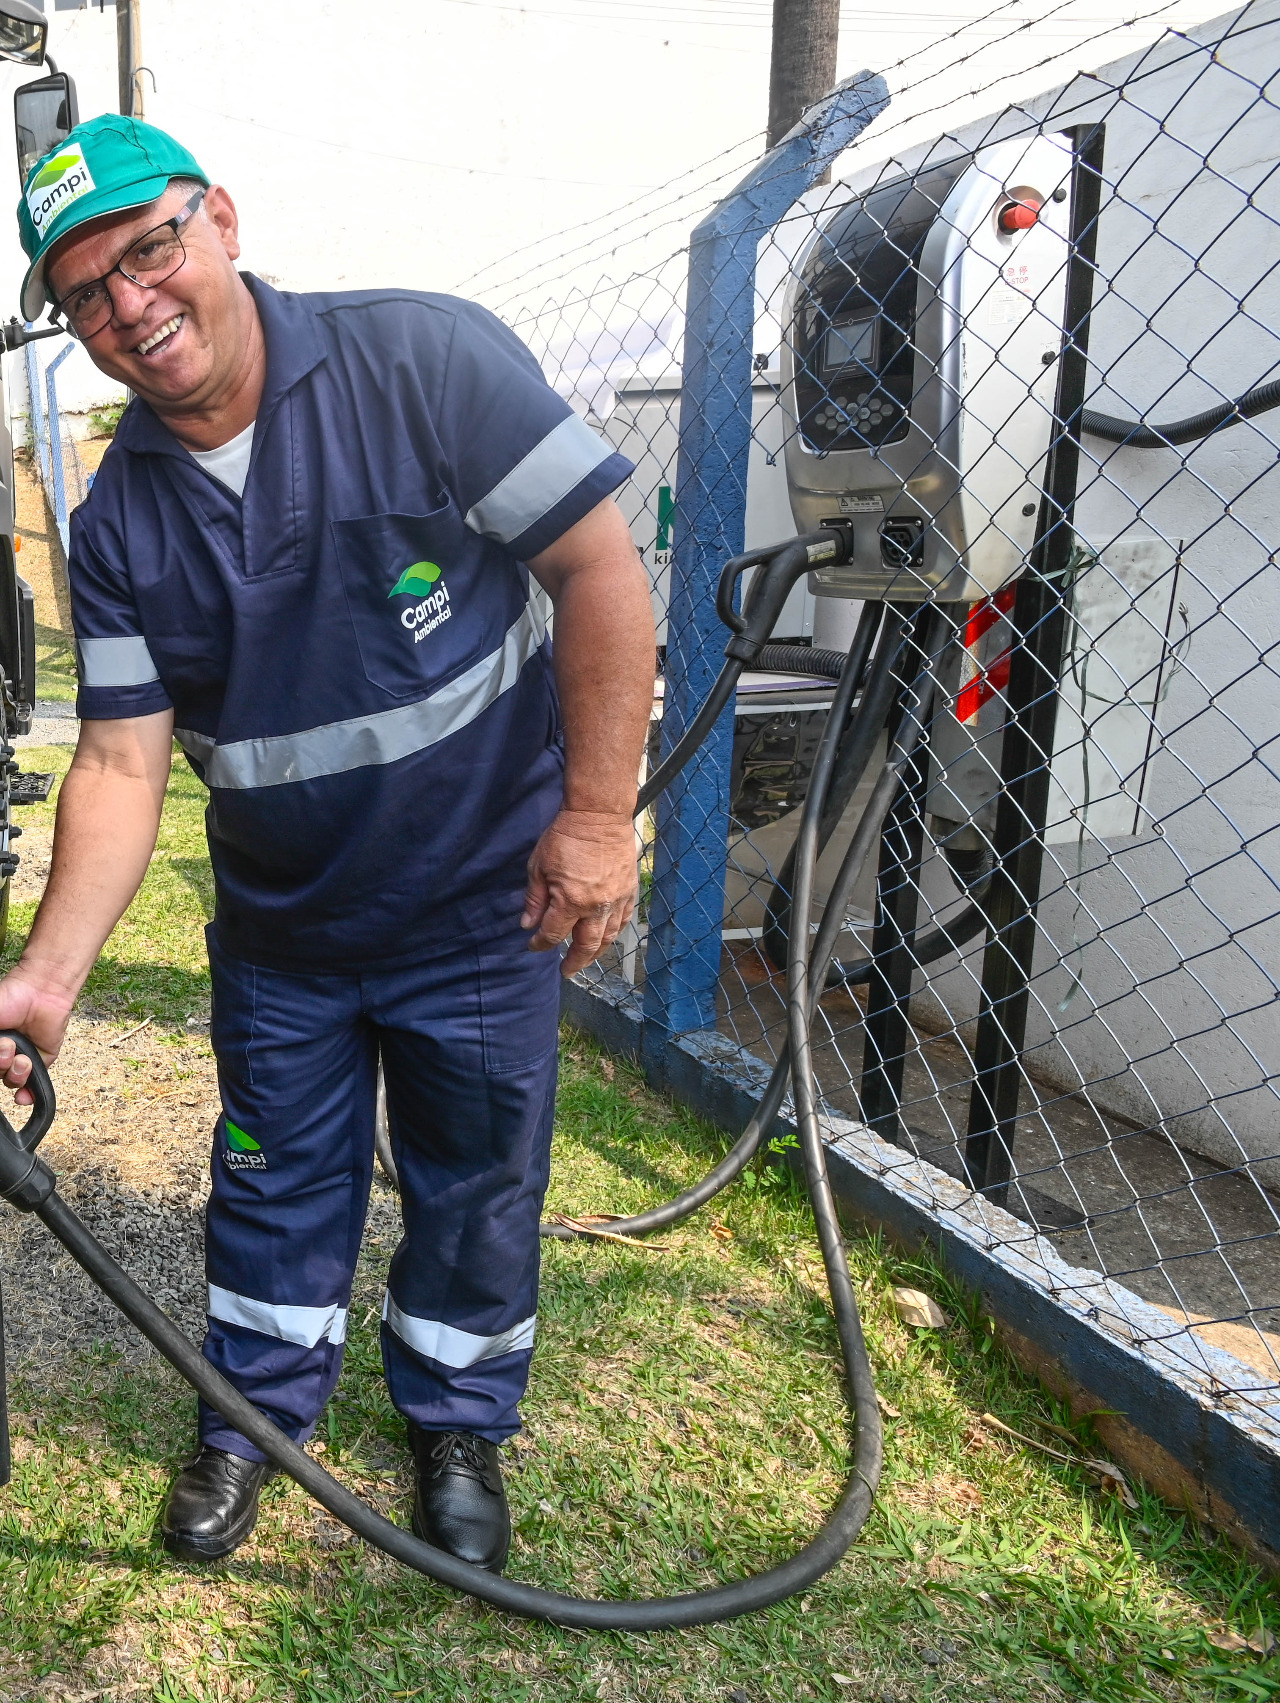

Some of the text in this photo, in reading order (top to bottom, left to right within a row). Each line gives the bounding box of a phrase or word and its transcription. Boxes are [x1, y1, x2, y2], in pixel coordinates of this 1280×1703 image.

[32, 167, 87, 226] Campi
[42, 185, 88, 233] Ambiental
[401, 581, 450, 629] Campi
[414, 605, 452, 643] Ambiental
